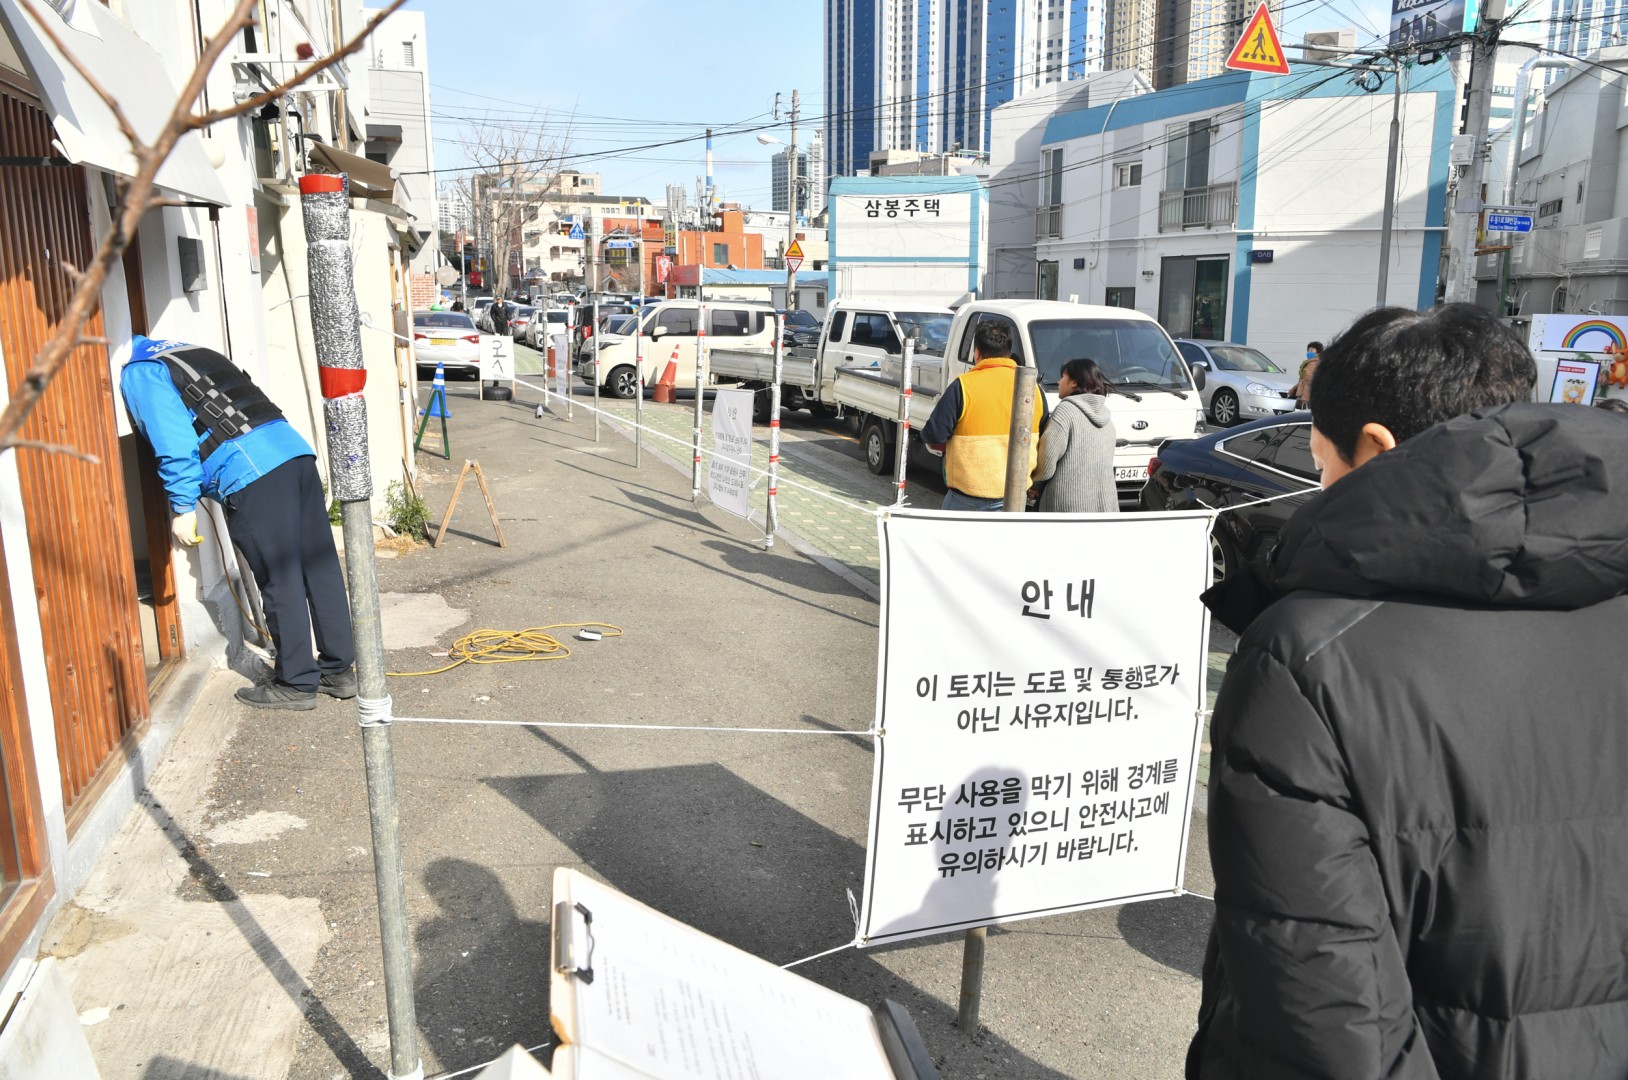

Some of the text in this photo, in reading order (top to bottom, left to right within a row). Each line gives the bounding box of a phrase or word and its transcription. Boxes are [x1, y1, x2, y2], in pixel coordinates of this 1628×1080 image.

[865, 199, 940, 218] 삼봉주택
[1133, 421, 1147, 429] KIA
[917, 663, 1179, 701] 이 토지는 도로 및 통행로가
[957, 697, 1138, 733] 아닌 사유지입니다.
[898, 759, 1178, 813] 무단 사용을 막기 위해 경계를
[904, 792, 1169, 846] 표시하고 있으니 안전사고에
[938, 830, 1138, 878] 유의하시기 바랍니다.
